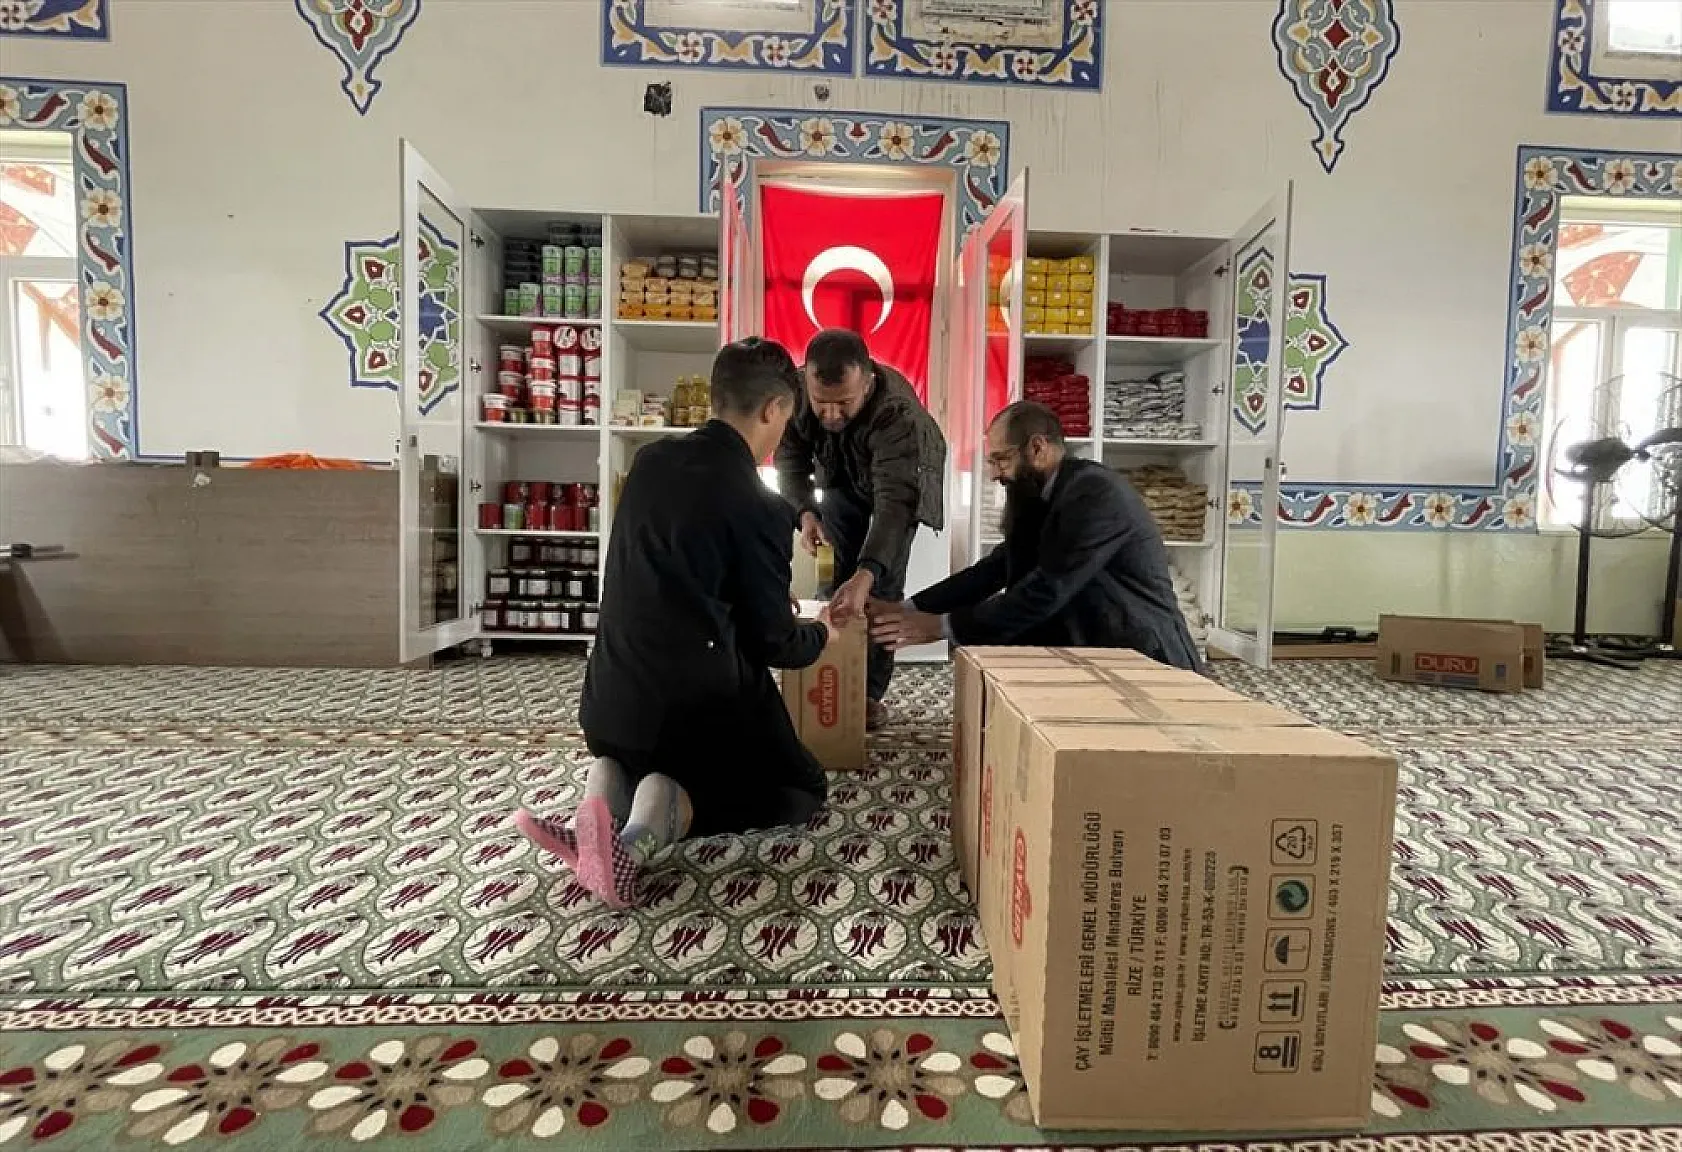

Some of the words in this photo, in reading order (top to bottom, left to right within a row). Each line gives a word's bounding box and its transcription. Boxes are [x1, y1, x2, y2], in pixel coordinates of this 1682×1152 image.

[1417, 656, 1477, 671] DURU
[1160, 828, 1171, 840] 03
[1287, 837, 1297, 848] 20
[1080, 812, 1101, 903] MÜDÜRLÜĞÜ
[1109, 830, 1124, 877] Bulvarı
[1159, 844, 1170, 856] 07
[1158, 861, 1170, 880] 213
[1158, 884, 1169, 903] 464
[1105, 882, 1121, 947] Menderes
[1128, 893, 1146, 954] TÜRKİYE
[1156, 907, 1168, 932] 0090
[1081, 908, 1096, 951] GENEL
[1154, 950, 1166, 961] 11
[1101, 952, 1118, 1015] Mahallesi
[1124, 966, 1143, 996] RİZE
[1153, 965, 1165, 978] 02
[1197, 964, 1209, 994] KAYIT
[1073, 955, 1095, 1042] İŞLETMELERİ
[1152, 981, 1164, 1000] 213
[1075, 1046, 1093, 1070] ÇAY
[1258, 1046, 1280, 1059] 8
